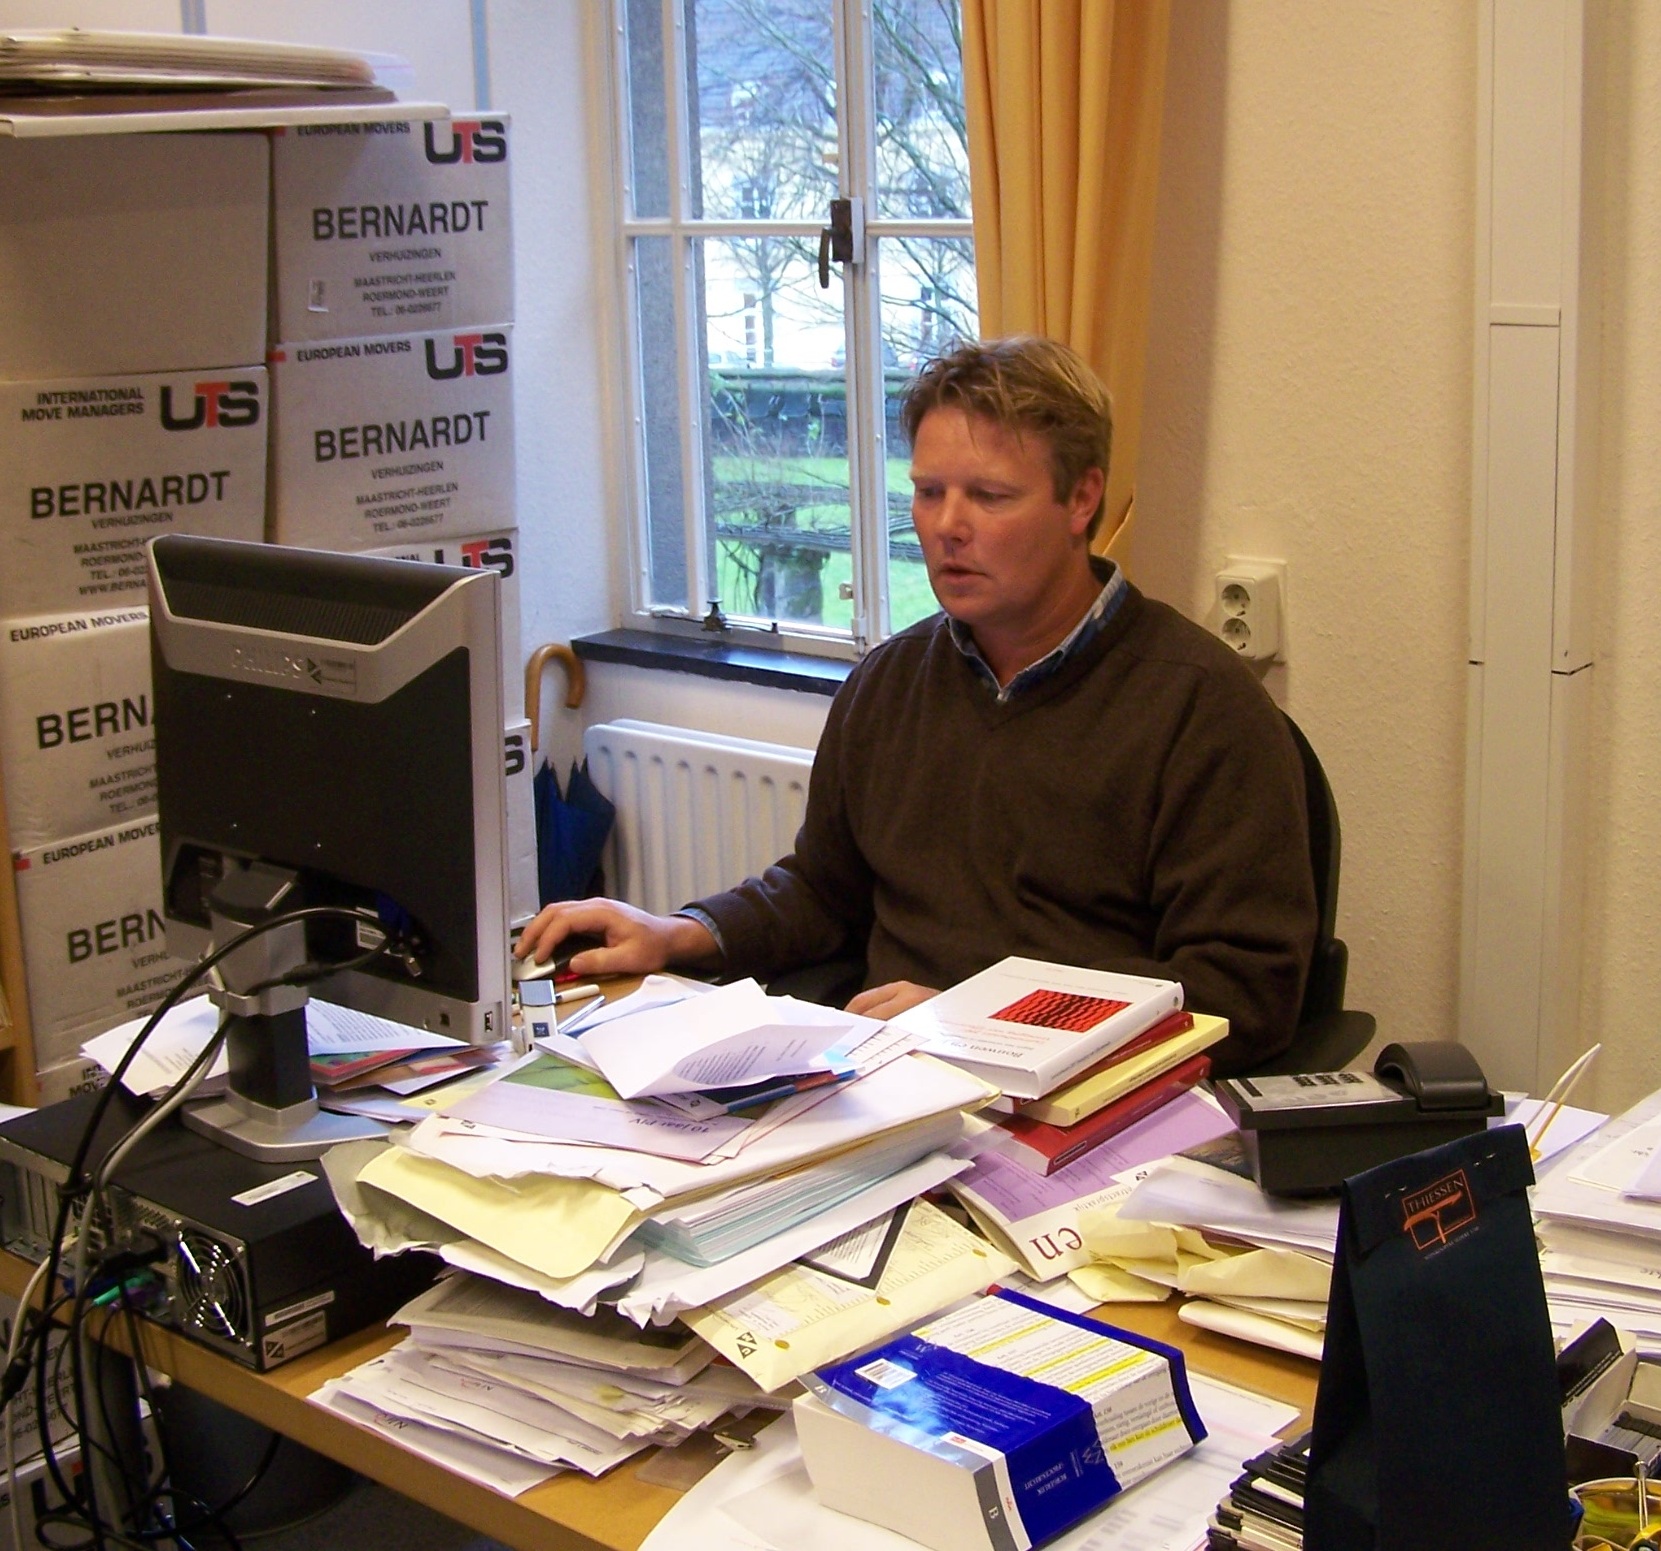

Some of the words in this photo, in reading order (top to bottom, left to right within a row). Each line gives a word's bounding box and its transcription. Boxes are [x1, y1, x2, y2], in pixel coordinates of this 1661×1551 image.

[297, 123, 360, 136] EUROPEAN
[363, 121, 410, 134] MOVERS
[424, 120, 507, 164] UTS
[312, 200, 489, 241] BERNARDT
[369, 248, 442, 263] VERHUIZINGEN
[297, 345, 360, 362] EUROPEAN
[364, 341, 411, 356] MOVERS
[424, 332, 508, 380] UTS
[22, 408, 63, 422] MOVE
[67, 402, 144, 420] MANAGERS
[37, 387, 144, 405] INTERNATIONAL
[160, 381, 260, 431] UTS
[313, 410, 490, 463] BERNARDT
[371, 461, 444, 479] VERHUIZINGEN
[30, 471, 230, 520] BERNARDT
[355, 482, 459, 505] MAASTRICHT-HEERLEN
[10, 620, 88, 643] EUROPEAN
[92, 611, 149, 628] MOVERS
[36, 694, 155, 750] BERN
[43, 836, 115, 864] EUROPEAN
[1407, 1176, 1465, 1213] THIESSEN
[1029, 1227, 1083, 1260] en
[987, 1504, 1000, 1519] B
